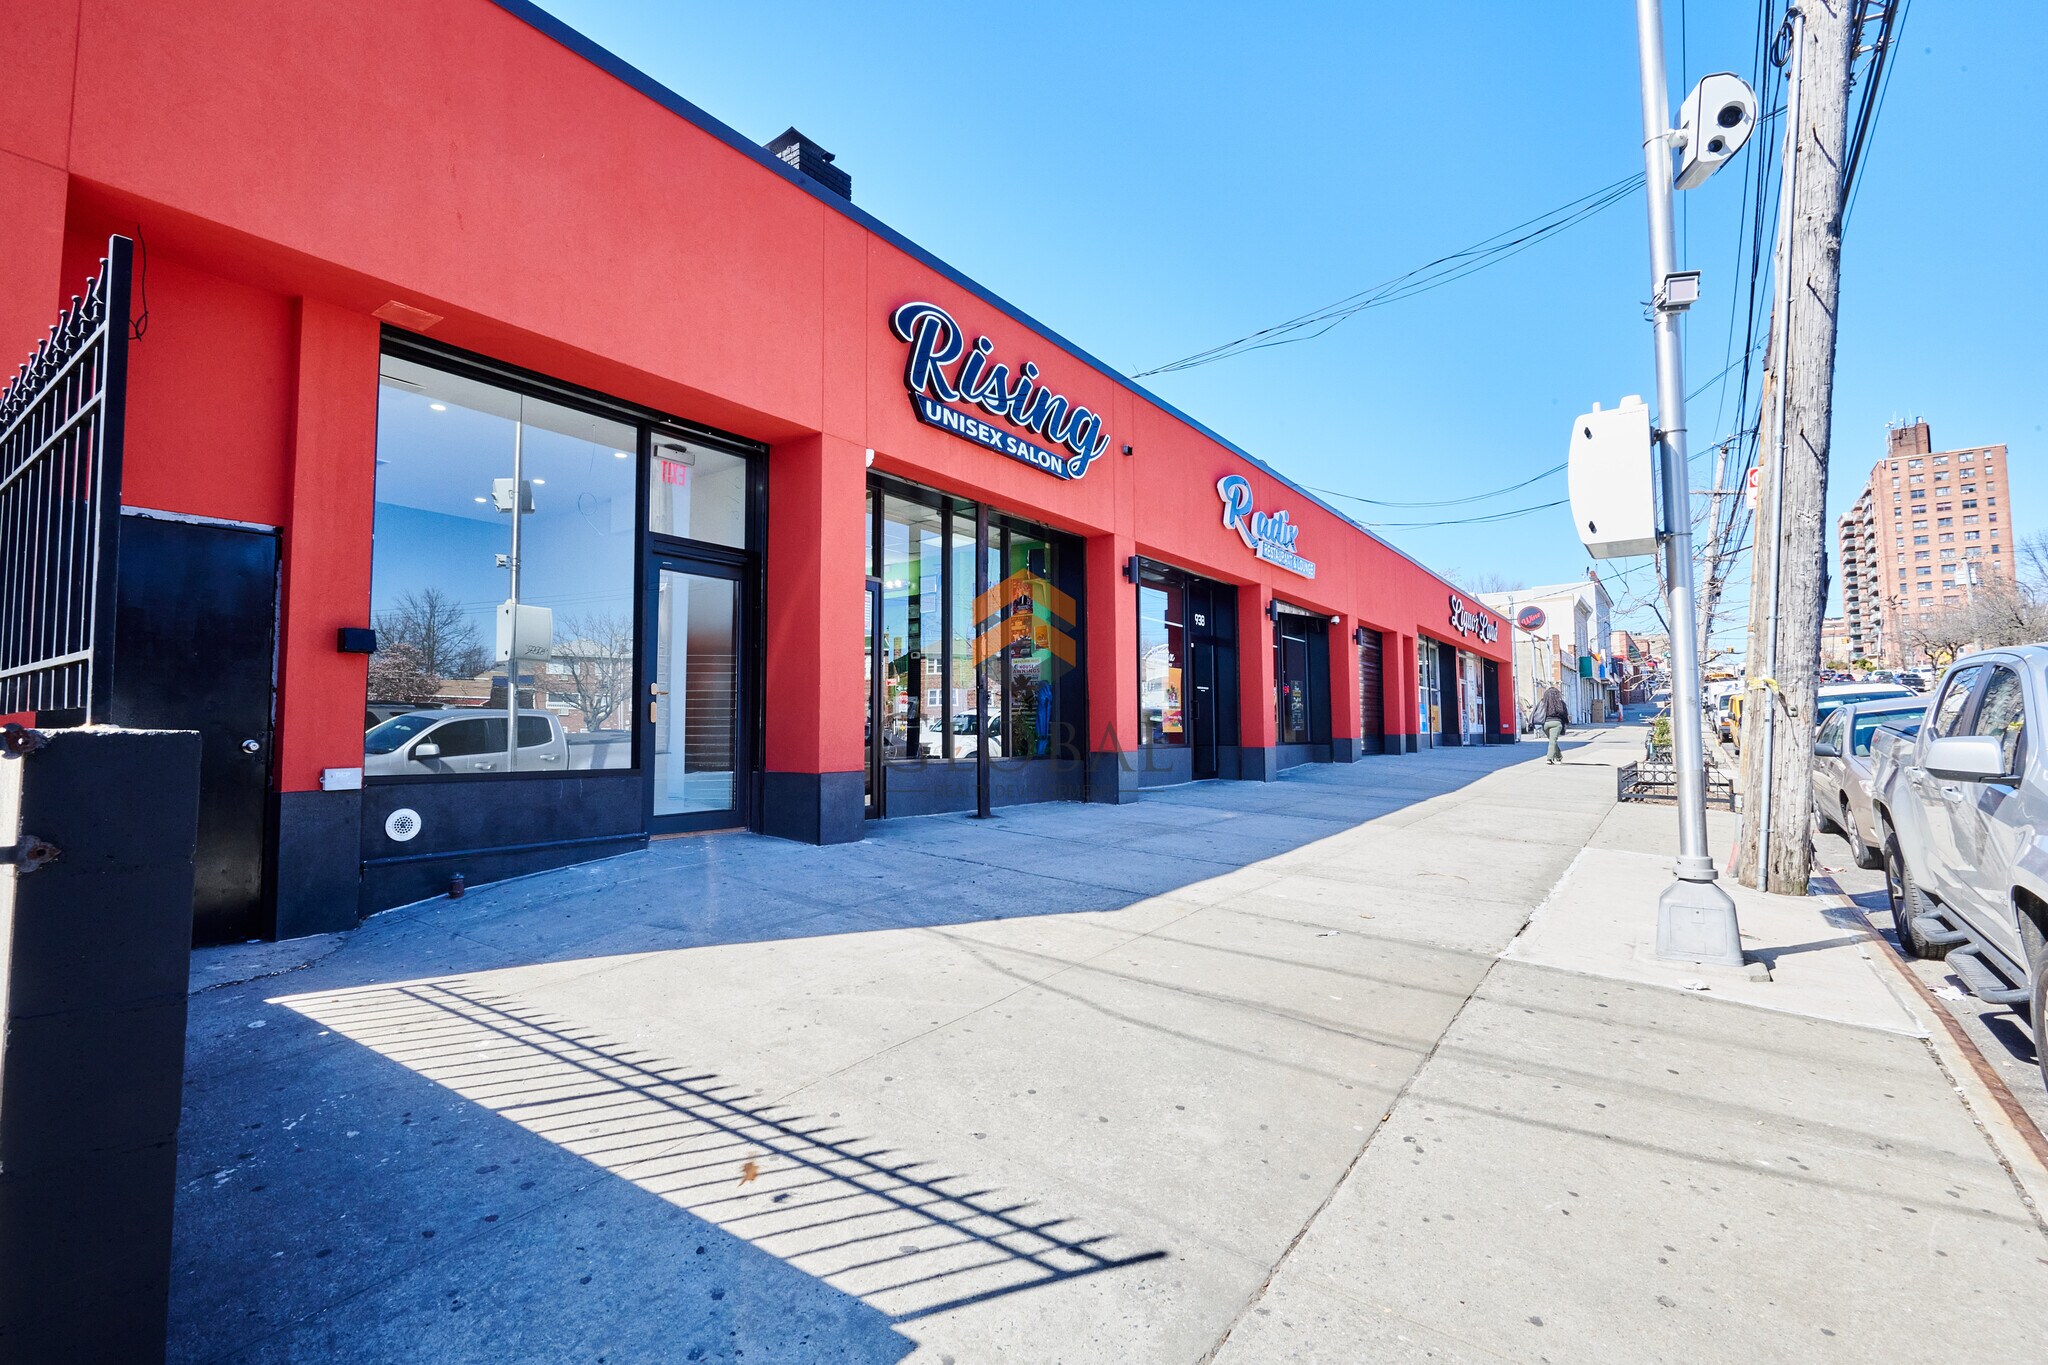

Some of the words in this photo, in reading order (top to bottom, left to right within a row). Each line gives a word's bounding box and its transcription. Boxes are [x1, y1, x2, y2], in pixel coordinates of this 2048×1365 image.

[892, 301, 1110, 479] Rising
[925, 400, 1002, 448] UNISEX
[1006, 437, 1062, 474] SALON
[1217, 474, 1298, 553] Radix
[1194, 613, 1205, 626] 938
[1451, 594, 1479, 637] Liquor
[1521, 612, 1541, 626] Wine
